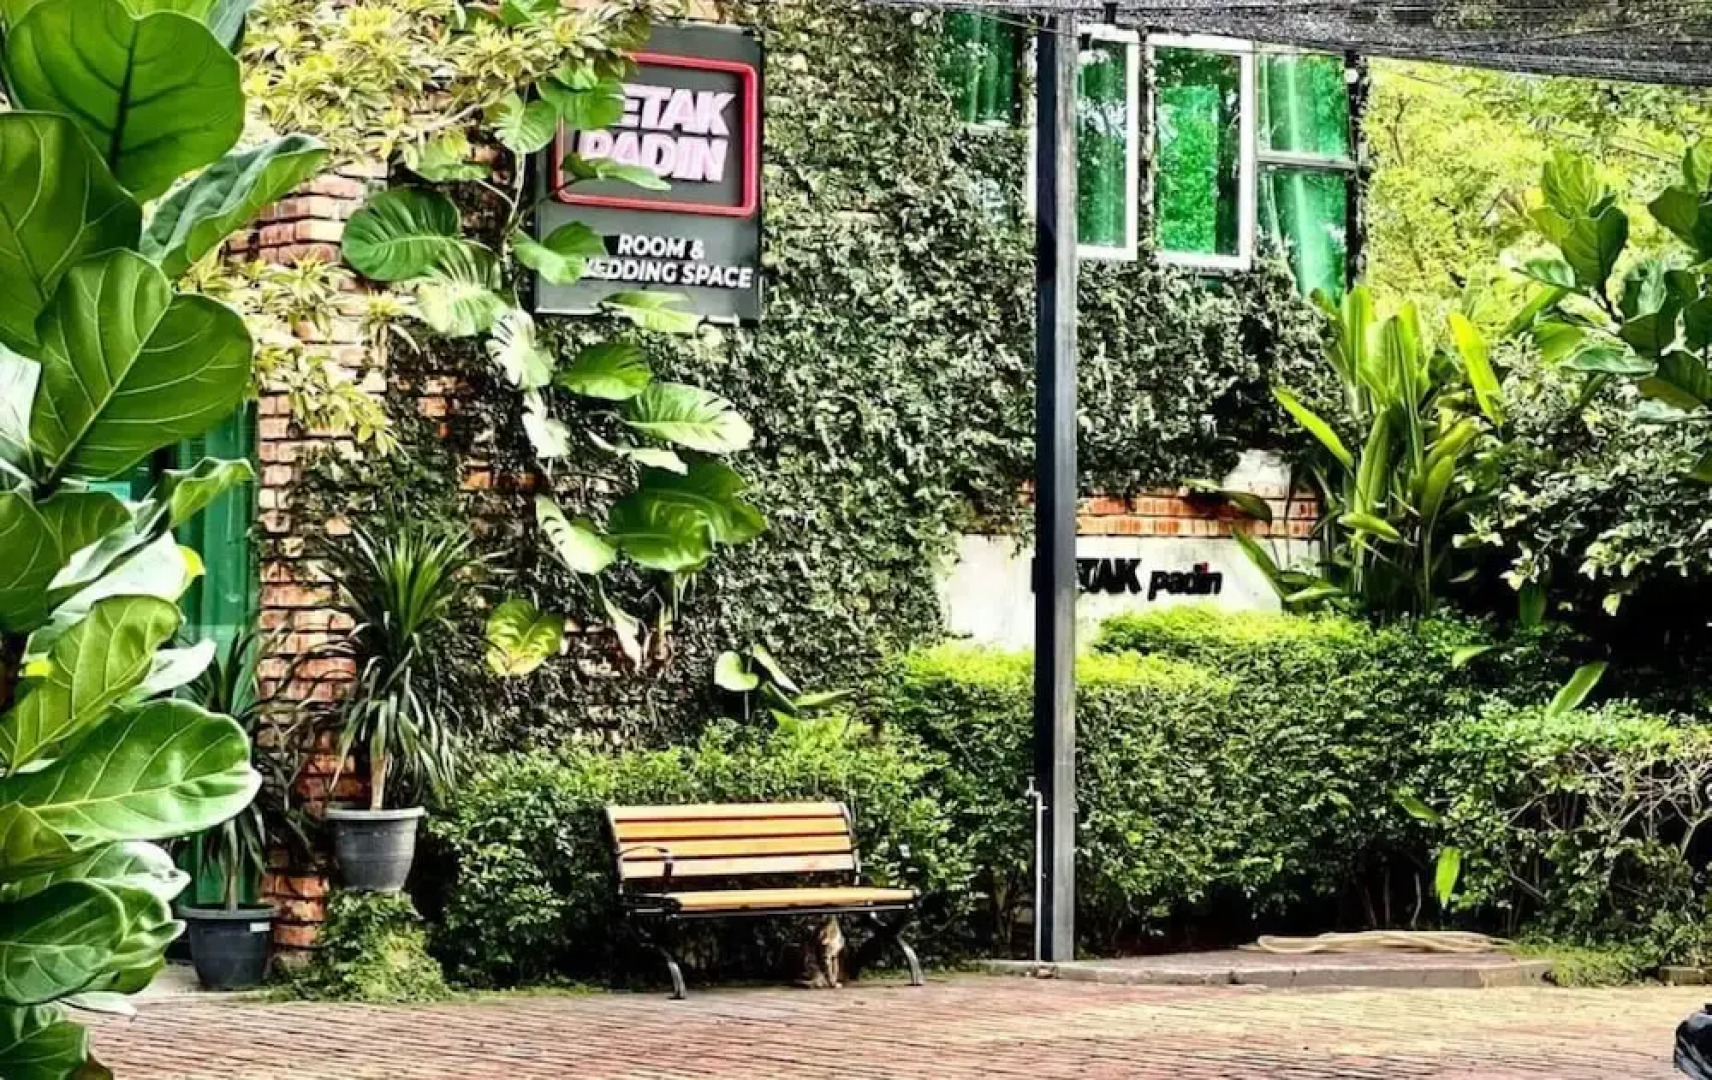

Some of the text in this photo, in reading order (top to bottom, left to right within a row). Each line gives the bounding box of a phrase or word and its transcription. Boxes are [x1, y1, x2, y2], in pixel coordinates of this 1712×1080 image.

[611, 84, 736, 136] ETAK
[617, 233, 705, 259] ROOM &
[682, 263, 753, 288] SPACE
[1147, 562, 1222, 600] padin
